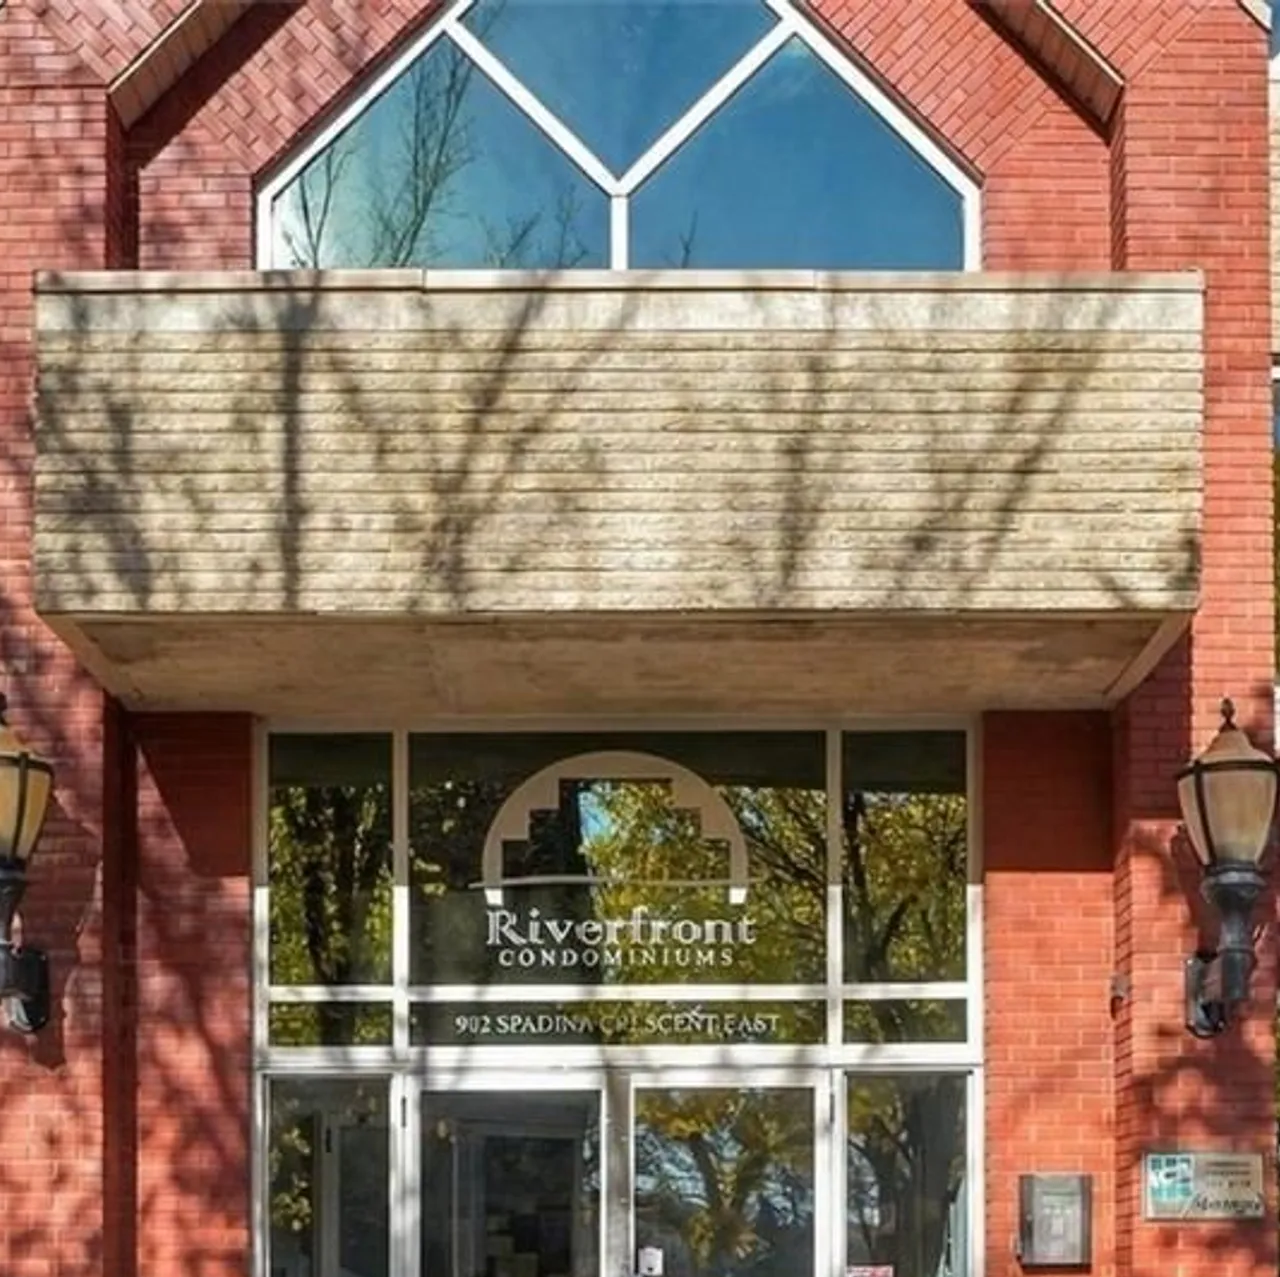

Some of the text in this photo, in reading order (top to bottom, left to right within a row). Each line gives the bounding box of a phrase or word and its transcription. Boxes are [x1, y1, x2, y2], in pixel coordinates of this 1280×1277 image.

[485, 906, 756, 946] Riverfront
[498, 949, 734, 967] CONDOMINIUMS
[455, 1014, 491, 1034] 902
[495, 1014, 593, 1034] SPADINA
